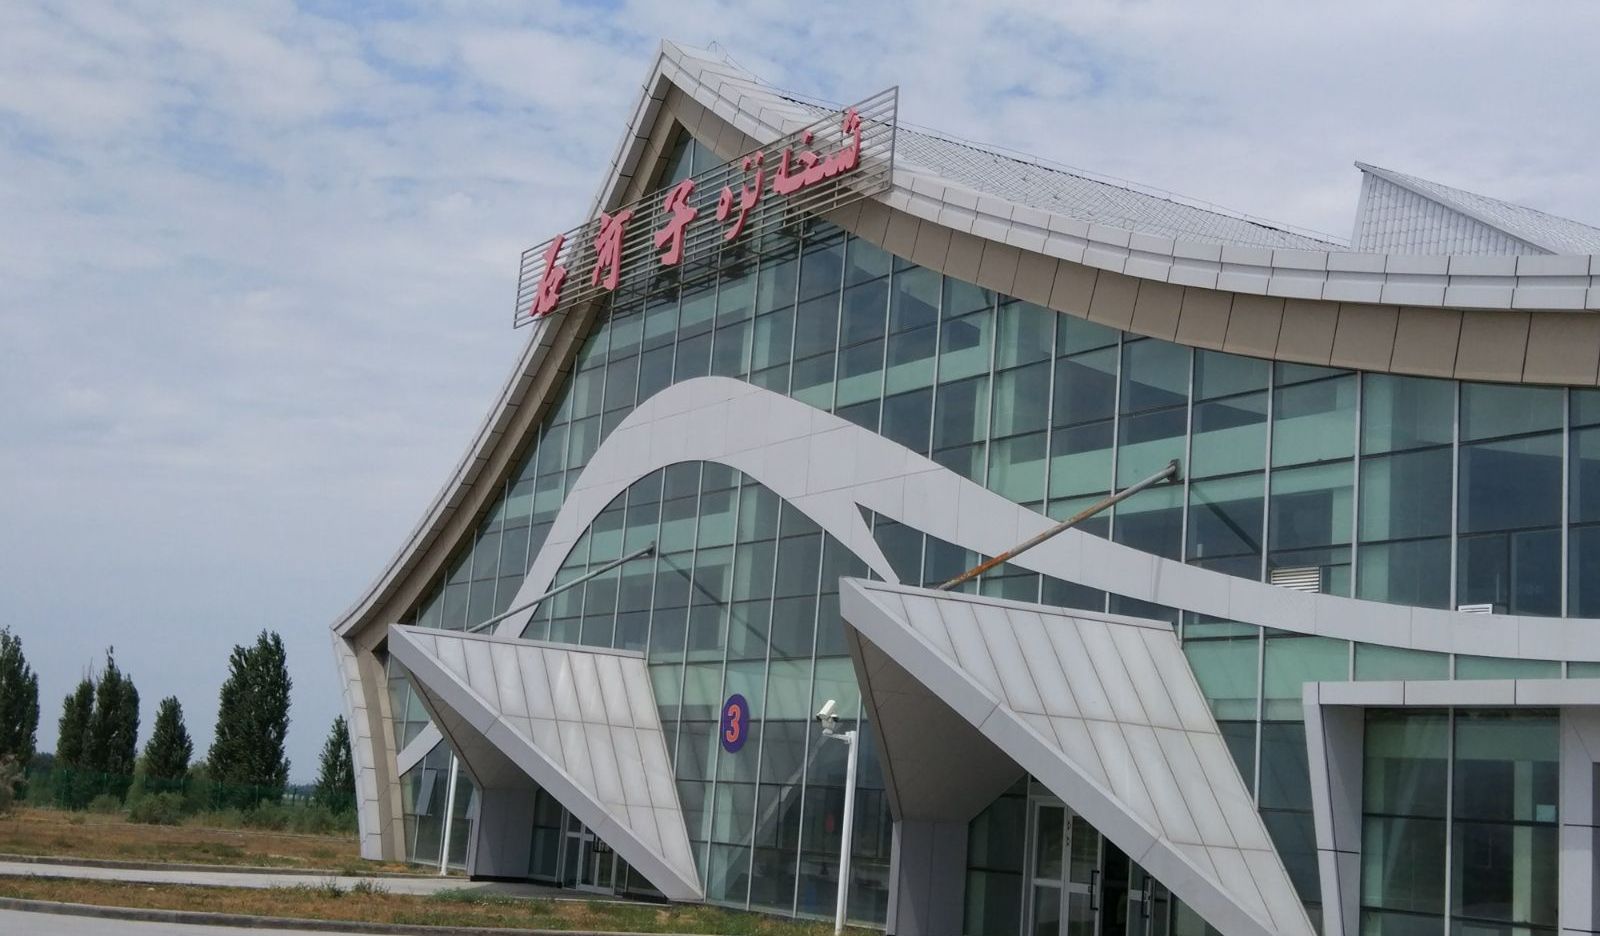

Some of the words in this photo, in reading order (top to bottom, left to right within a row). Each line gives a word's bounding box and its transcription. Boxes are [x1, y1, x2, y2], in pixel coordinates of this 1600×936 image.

[528, 178, 698, 317] 石河子
[726, 704, 741, 743] 3
